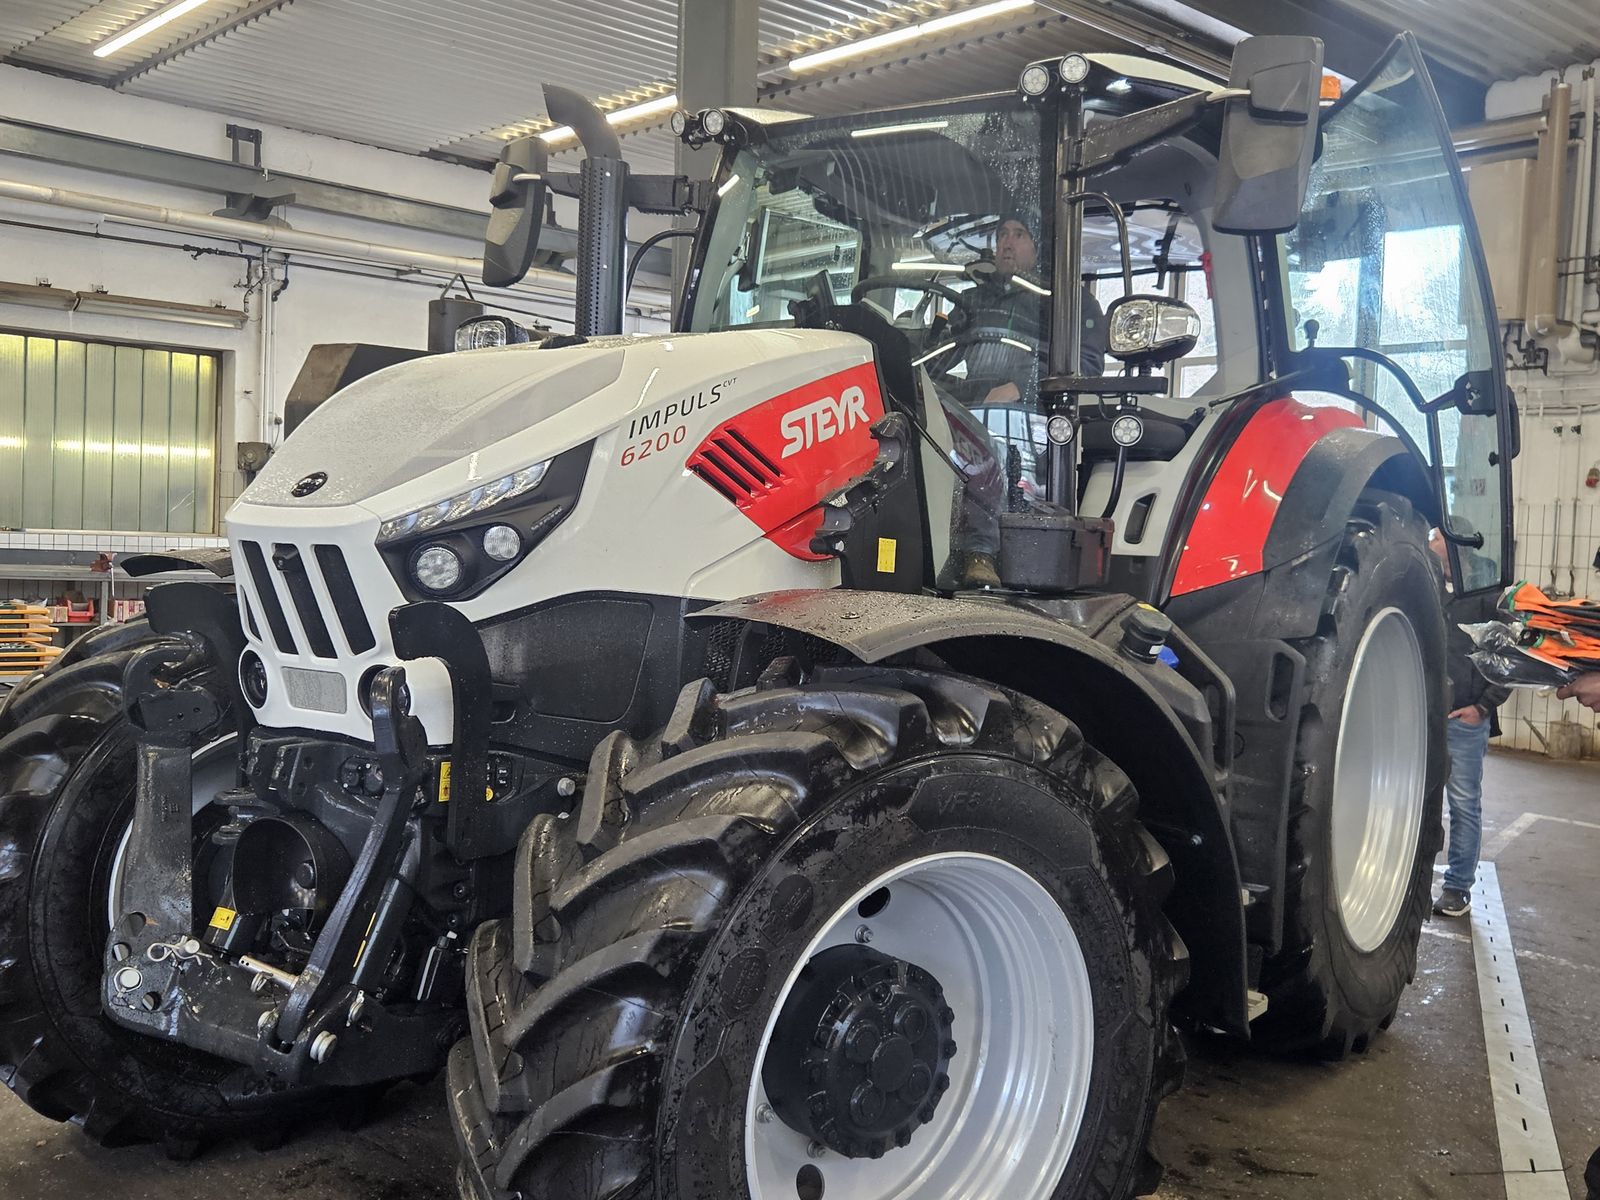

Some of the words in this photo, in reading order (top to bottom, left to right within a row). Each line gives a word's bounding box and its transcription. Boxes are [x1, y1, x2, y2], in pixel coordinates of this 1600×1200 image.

[628, 383, 722, 440] IMPULS
[722, 377, 737, 388] CVT
[780, 385, 870, 459] STEYR
[620, 425, 687, 467] 6200
